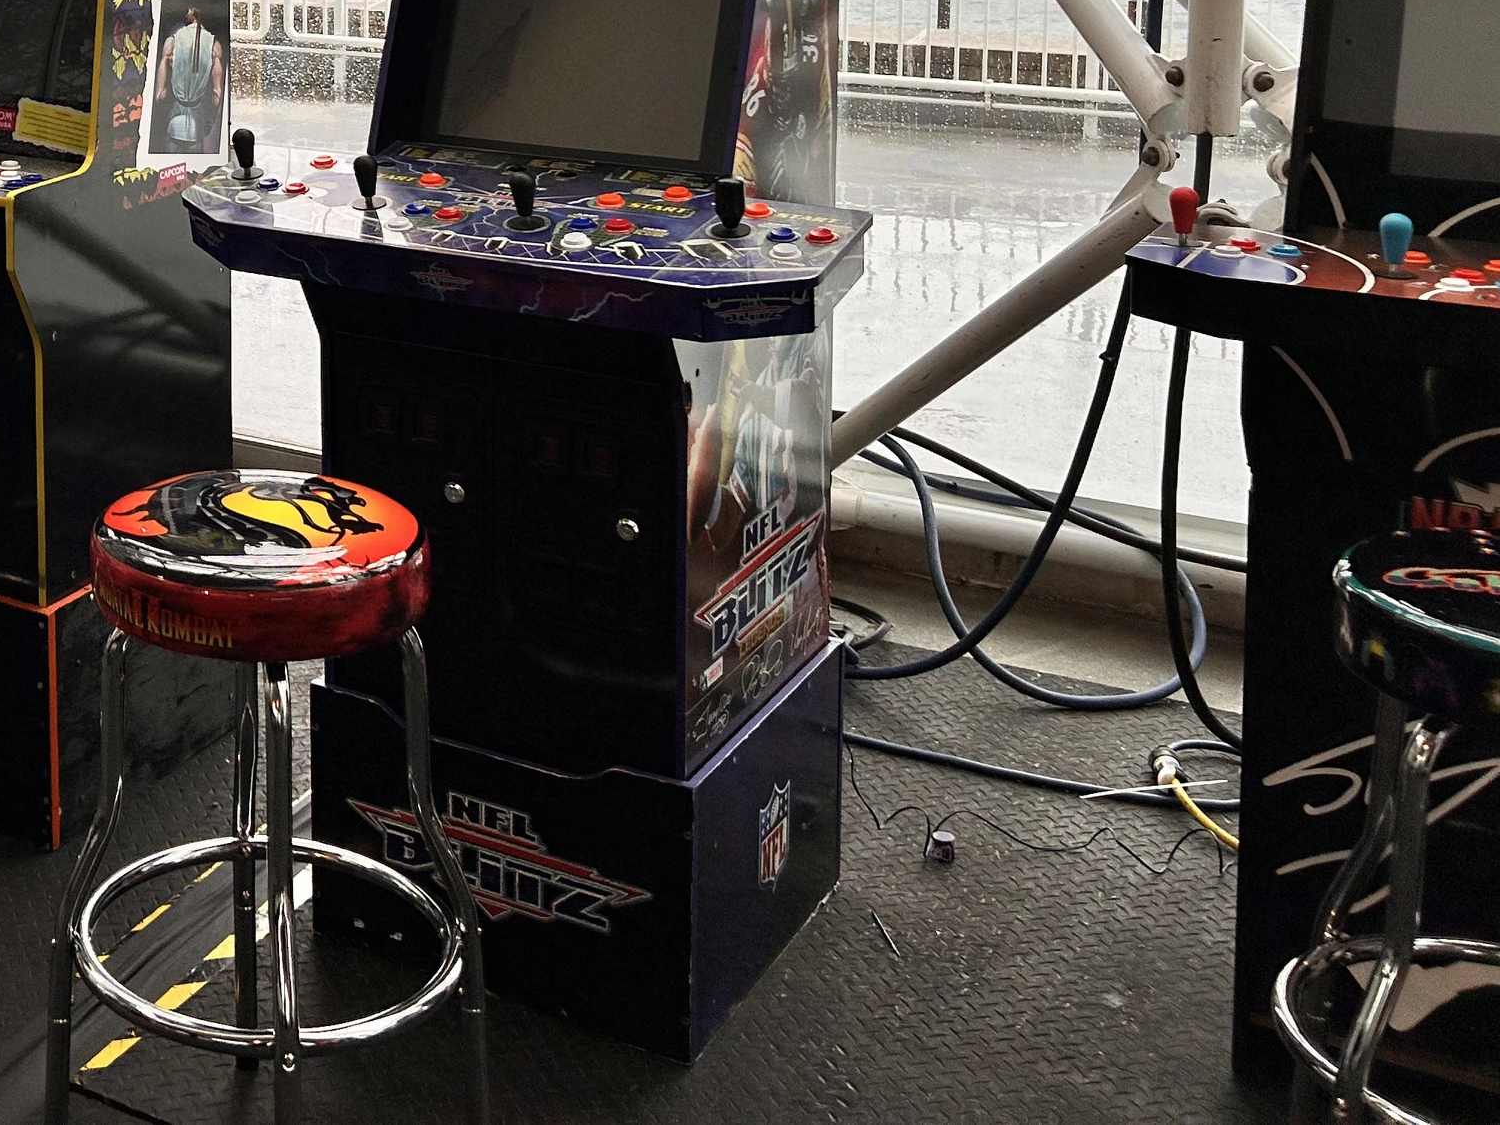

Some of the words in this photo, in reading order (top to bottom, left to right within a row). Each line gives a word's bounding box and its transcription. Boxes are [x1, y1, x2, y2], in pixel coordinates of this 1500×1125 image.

[159, 165, 186, 180] CAPCOM
[628, 202, 689, 214] START
[743, 504, 782, 557] NFL
[710, 527, 813, 659] BLITZ
[447, 791, 540, 843] NFL
[761, 817, 790, 885] NFL
